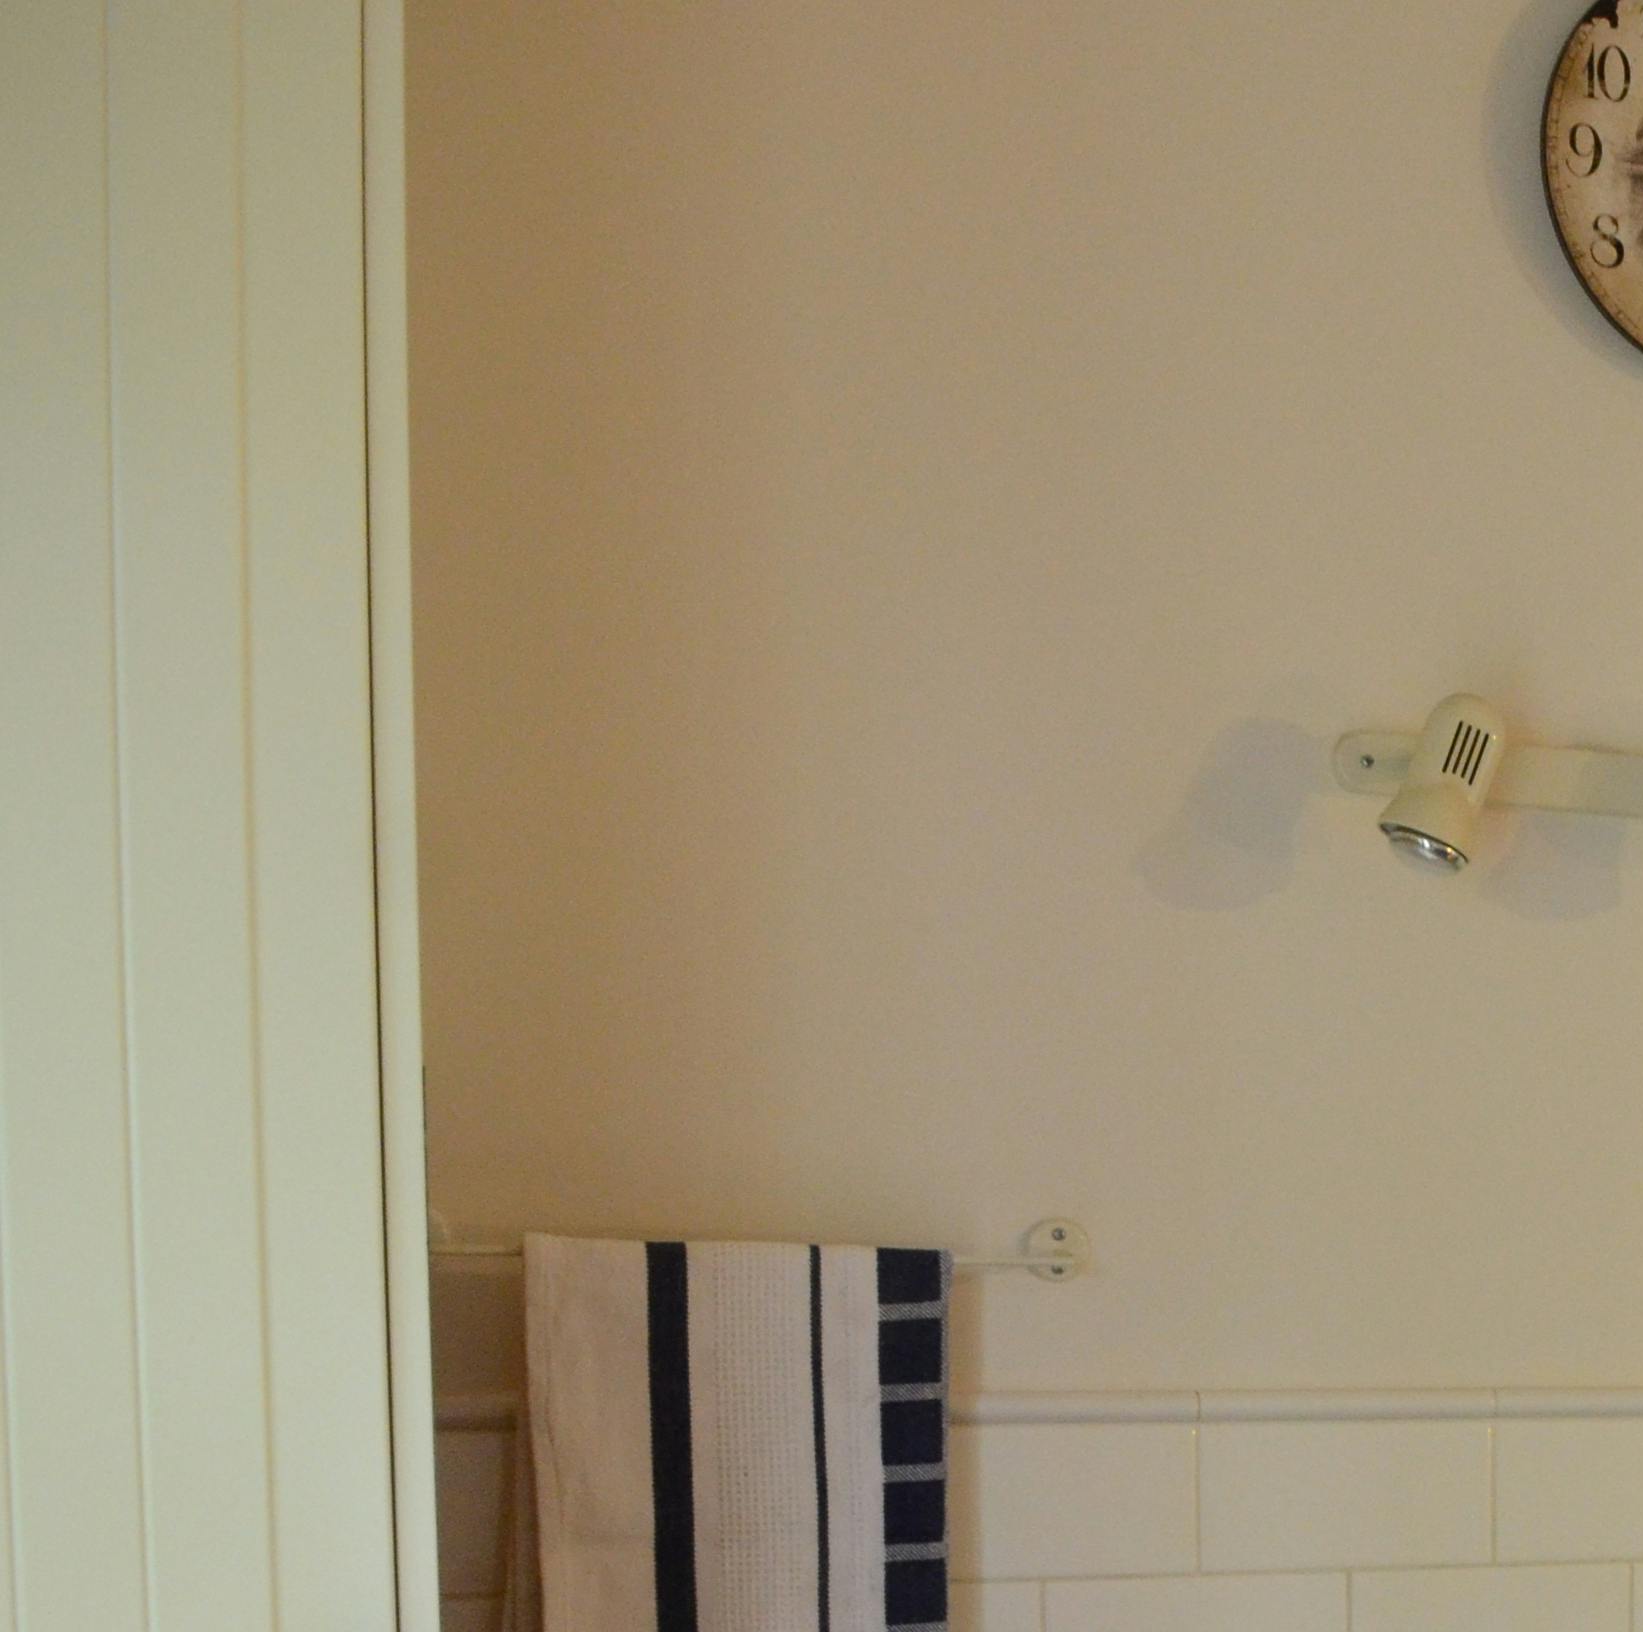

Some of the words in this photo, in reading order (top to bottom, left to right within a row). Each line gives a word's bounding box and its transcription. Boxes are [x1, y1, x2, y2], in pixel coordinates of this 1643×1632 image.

[1585, 43, 1632, 102] 10
[1566, 122, 1603, 178] 9
[1590, 213, 1625, 268] 8
